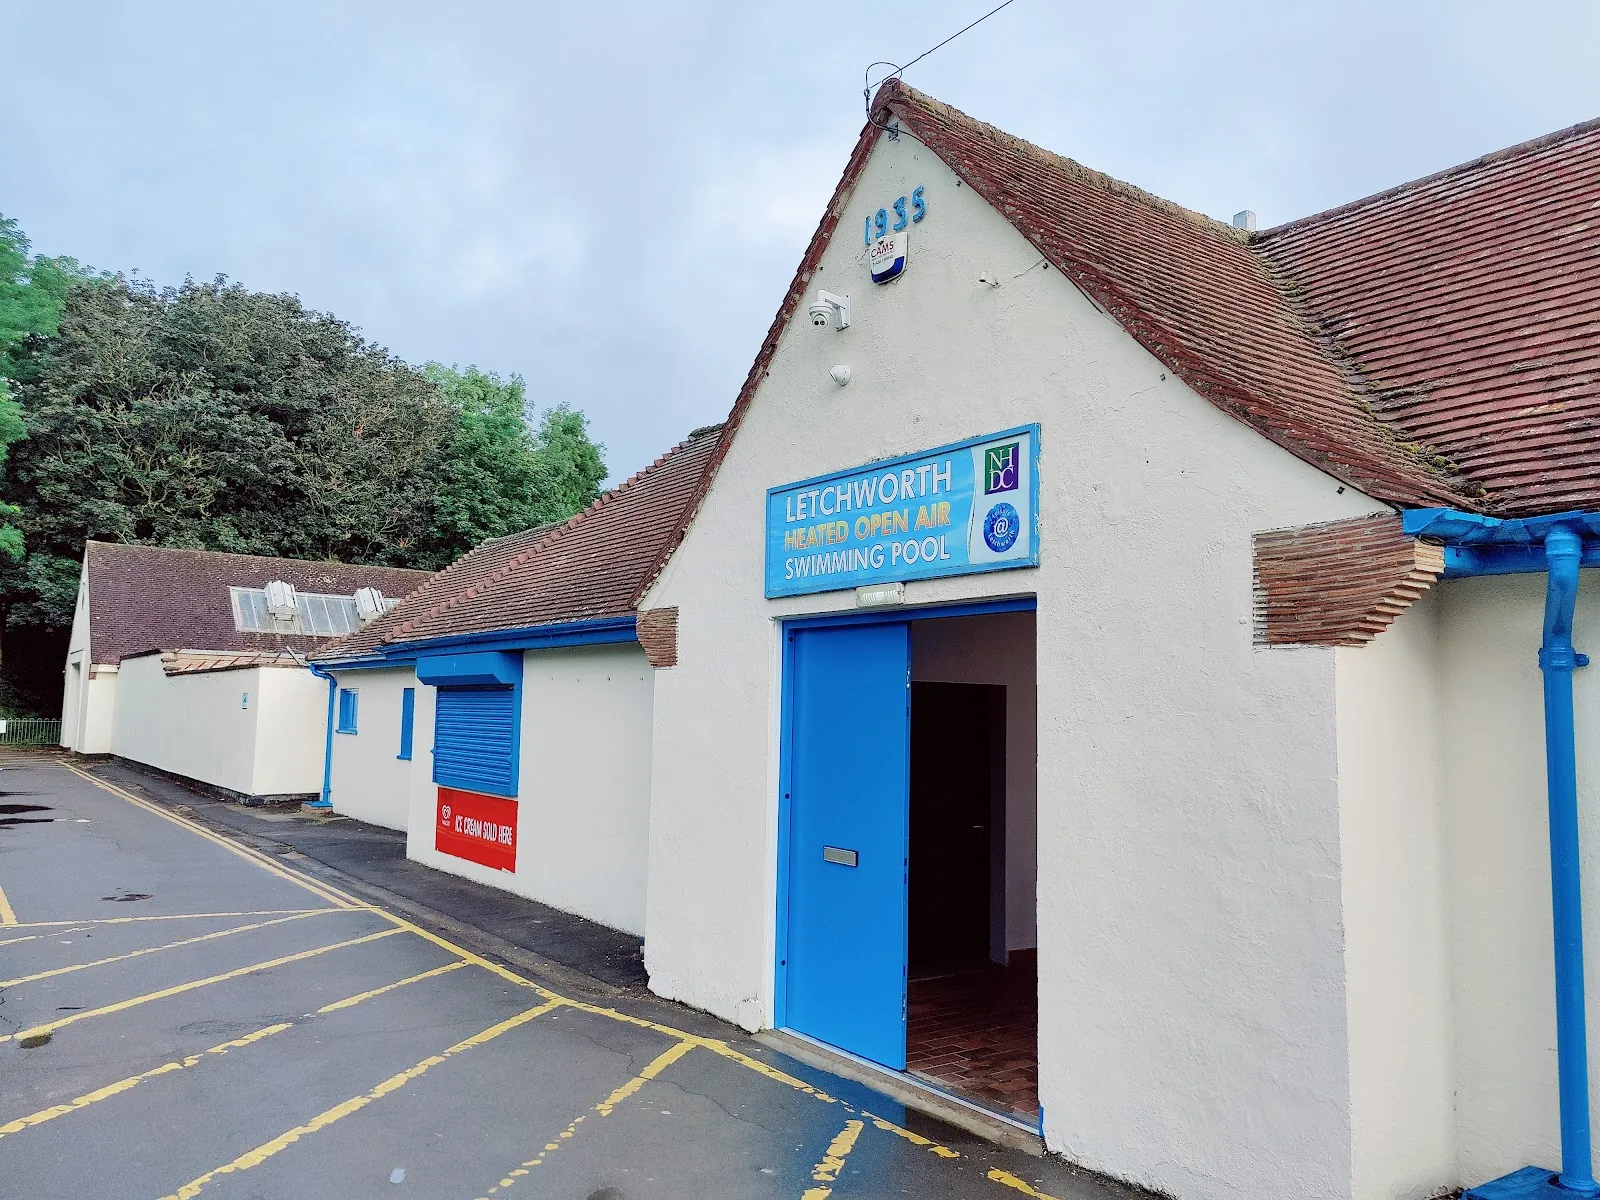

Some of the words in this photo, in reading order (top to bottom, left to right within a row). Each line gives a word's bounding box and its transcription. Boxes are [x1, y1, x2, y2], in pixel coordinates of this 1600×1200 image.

[864, 184, 925, 246] 1935
[870, 240, 895, 258] CAMS
[786, 460, 951, 523] LETCHWORTH
[784, 520, 849, 552] HEATED
[854, 508, 908, 540] OPEN
[914, 501, 951, 531] AIR
[784, 545, 885, 580] SWIMMING
[891, 534, 951, 566] POOL
[455, 815, 463, 833] ICE
[464, 817, 482, 838] CREAM
[483, 820, 497, 842] SOLD
[498, 825, 513, 846] HERE
